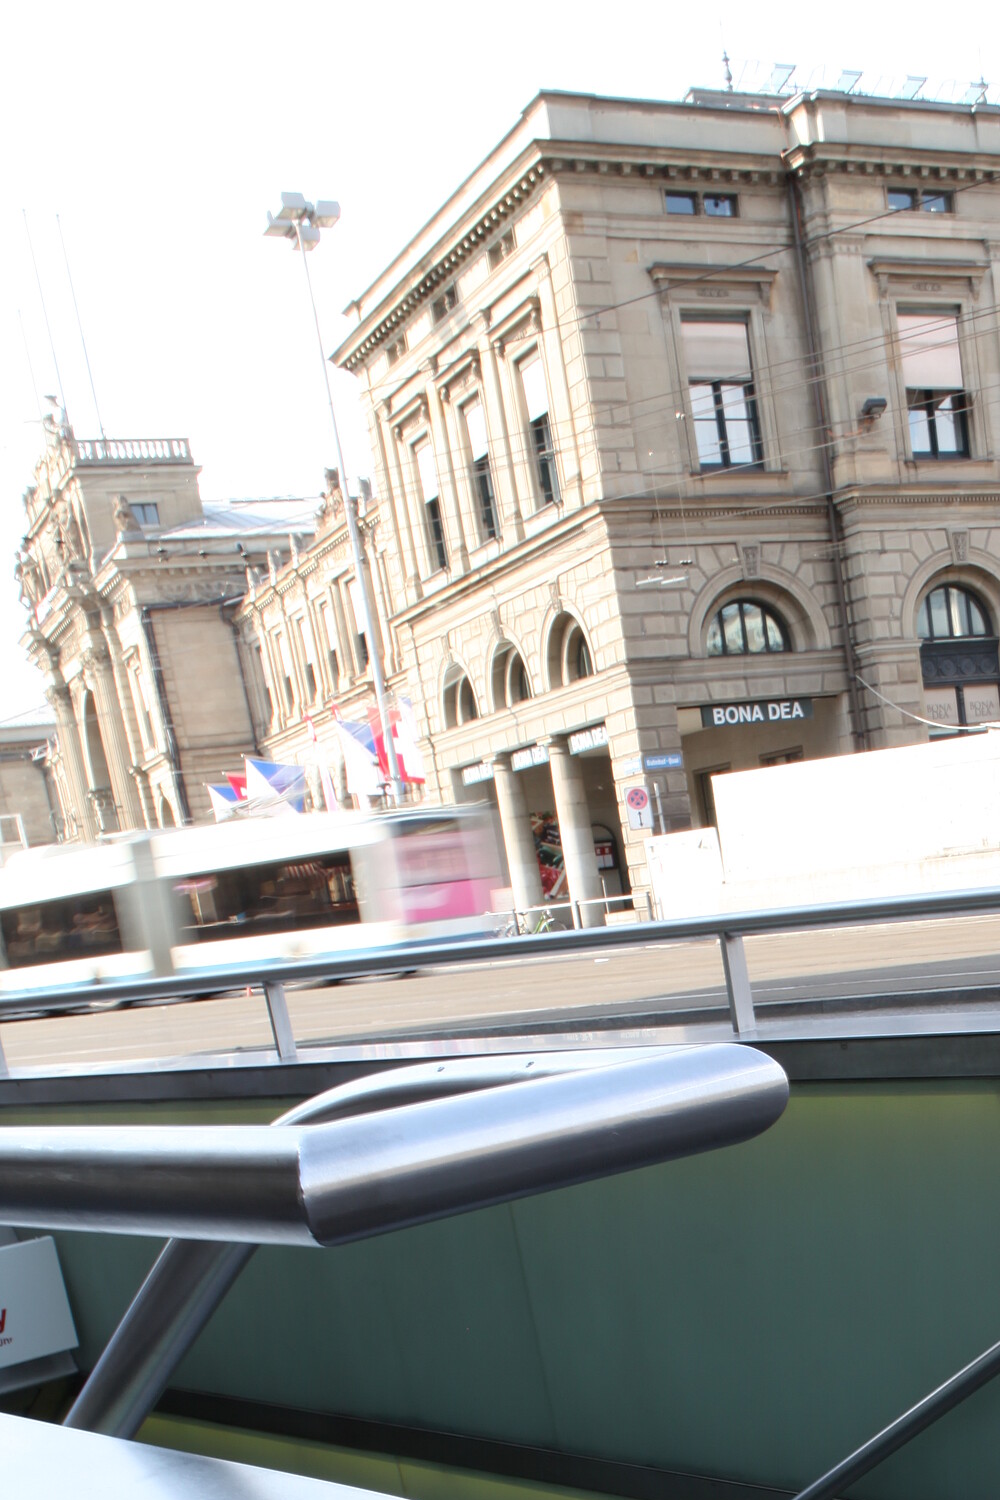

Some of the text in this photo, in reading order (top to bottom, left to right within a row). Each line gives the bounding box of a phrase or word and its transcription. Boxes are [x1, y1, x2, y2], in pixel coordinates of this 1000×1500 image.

[927, 703, 953, 713] BONA
[970, 701, 994, 710] BONA
[712, 701, 805, 725] BONA DEA
[932, 710, 949, 720] DEA
[975, 708, 992, 717] DEA
